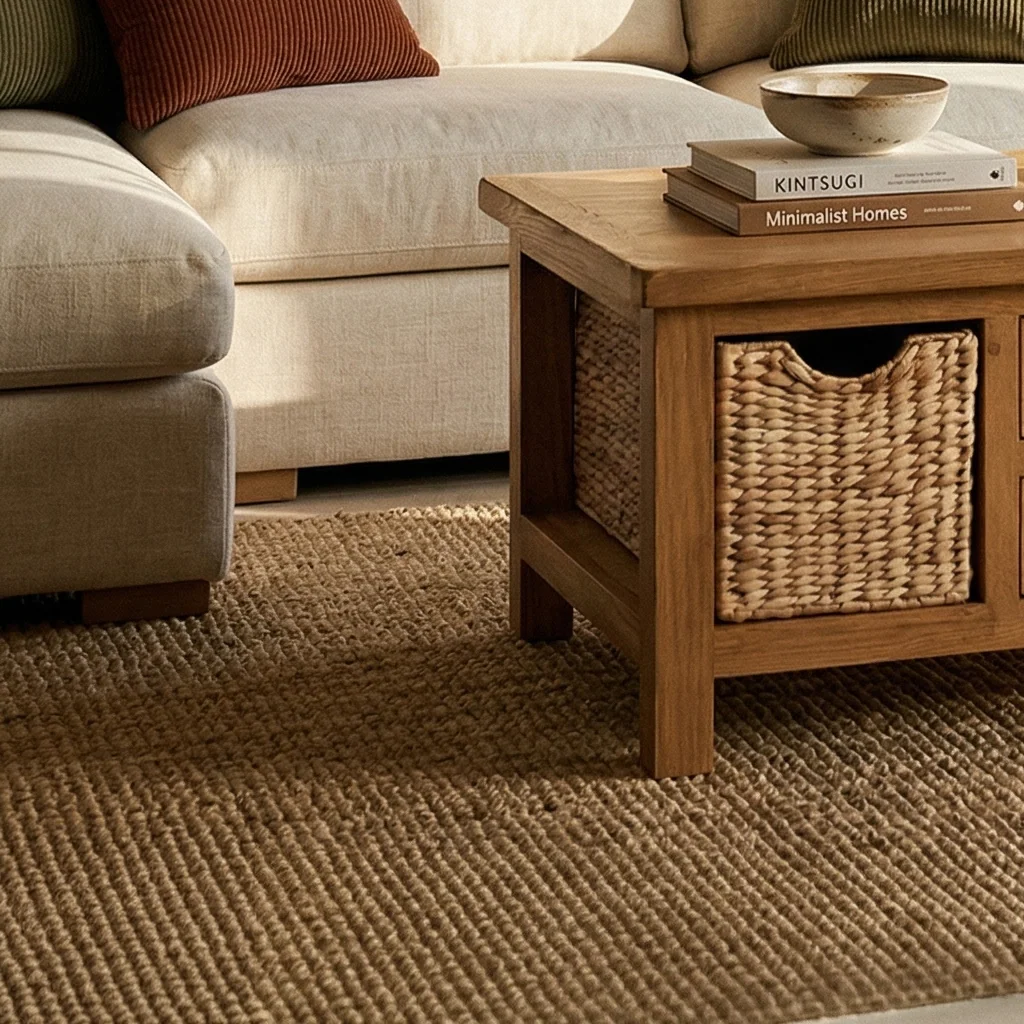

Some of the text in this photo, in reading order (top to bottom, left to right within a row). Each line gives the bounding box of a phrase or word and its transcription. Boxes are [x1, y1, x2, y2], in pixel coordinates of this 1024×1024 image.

[775, 174, 864, 193] KINTSUGI
[766, 207, 848, 227] Minimalist
[852, 206, 908, 223] Homes
